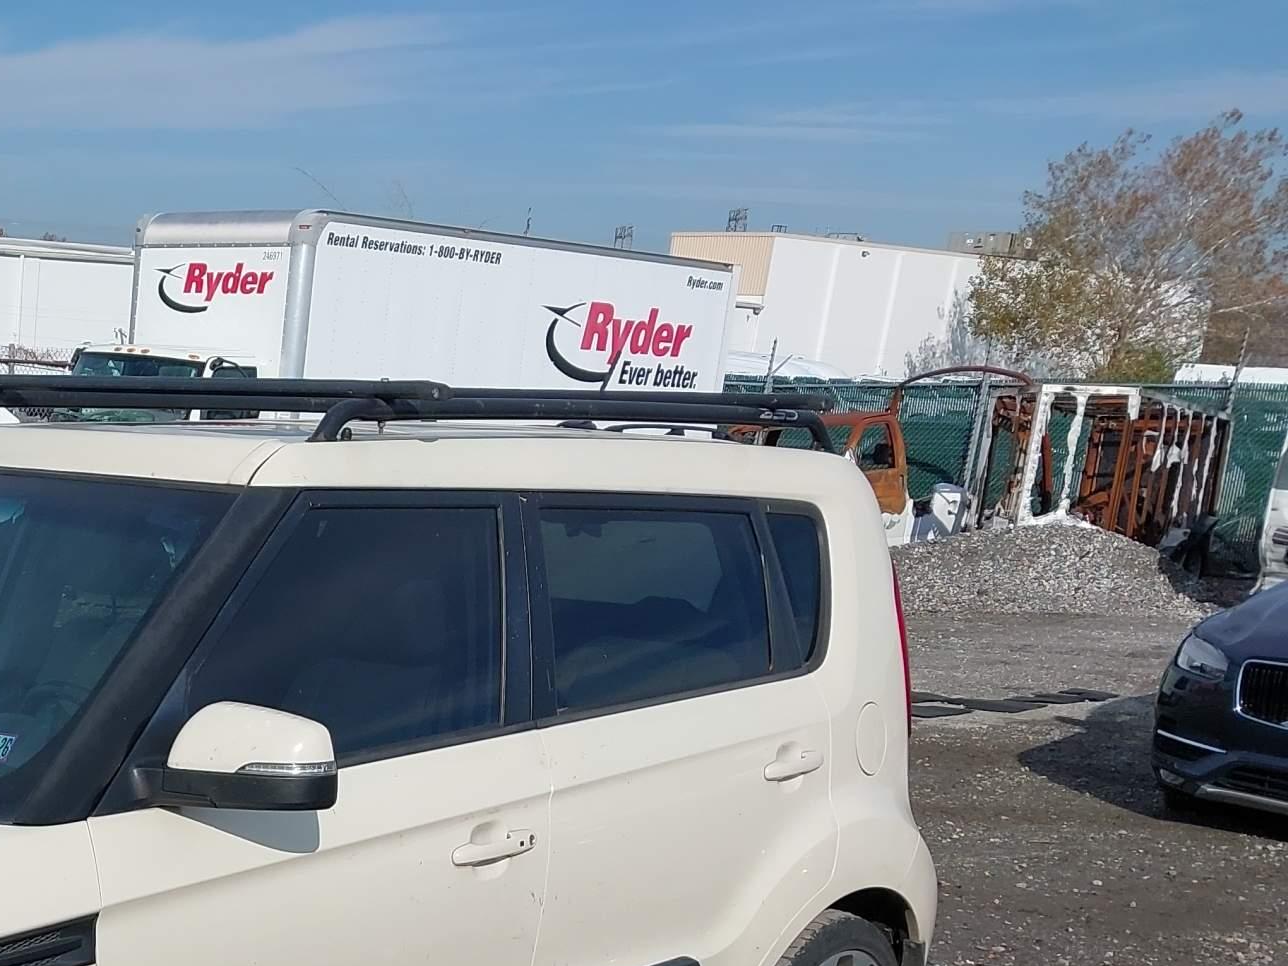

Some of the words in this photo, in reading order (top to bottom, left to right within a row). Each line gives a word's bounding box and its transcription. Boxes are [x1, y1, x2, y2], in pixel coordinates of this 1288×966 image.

[327, 232, 359, 248] Rental
[362, 236, 425, 256] Reservations:
[429, 244, 502, 265] 1-800-BY-RYDER
[183, 262, 274, 302] Ryder
[687, 276, 723, 291] Ryder.com
[580, 301, 693, 366] Ryder
[618, 361, 652, 385] Ever
[653, 364, 698, 389] better.
